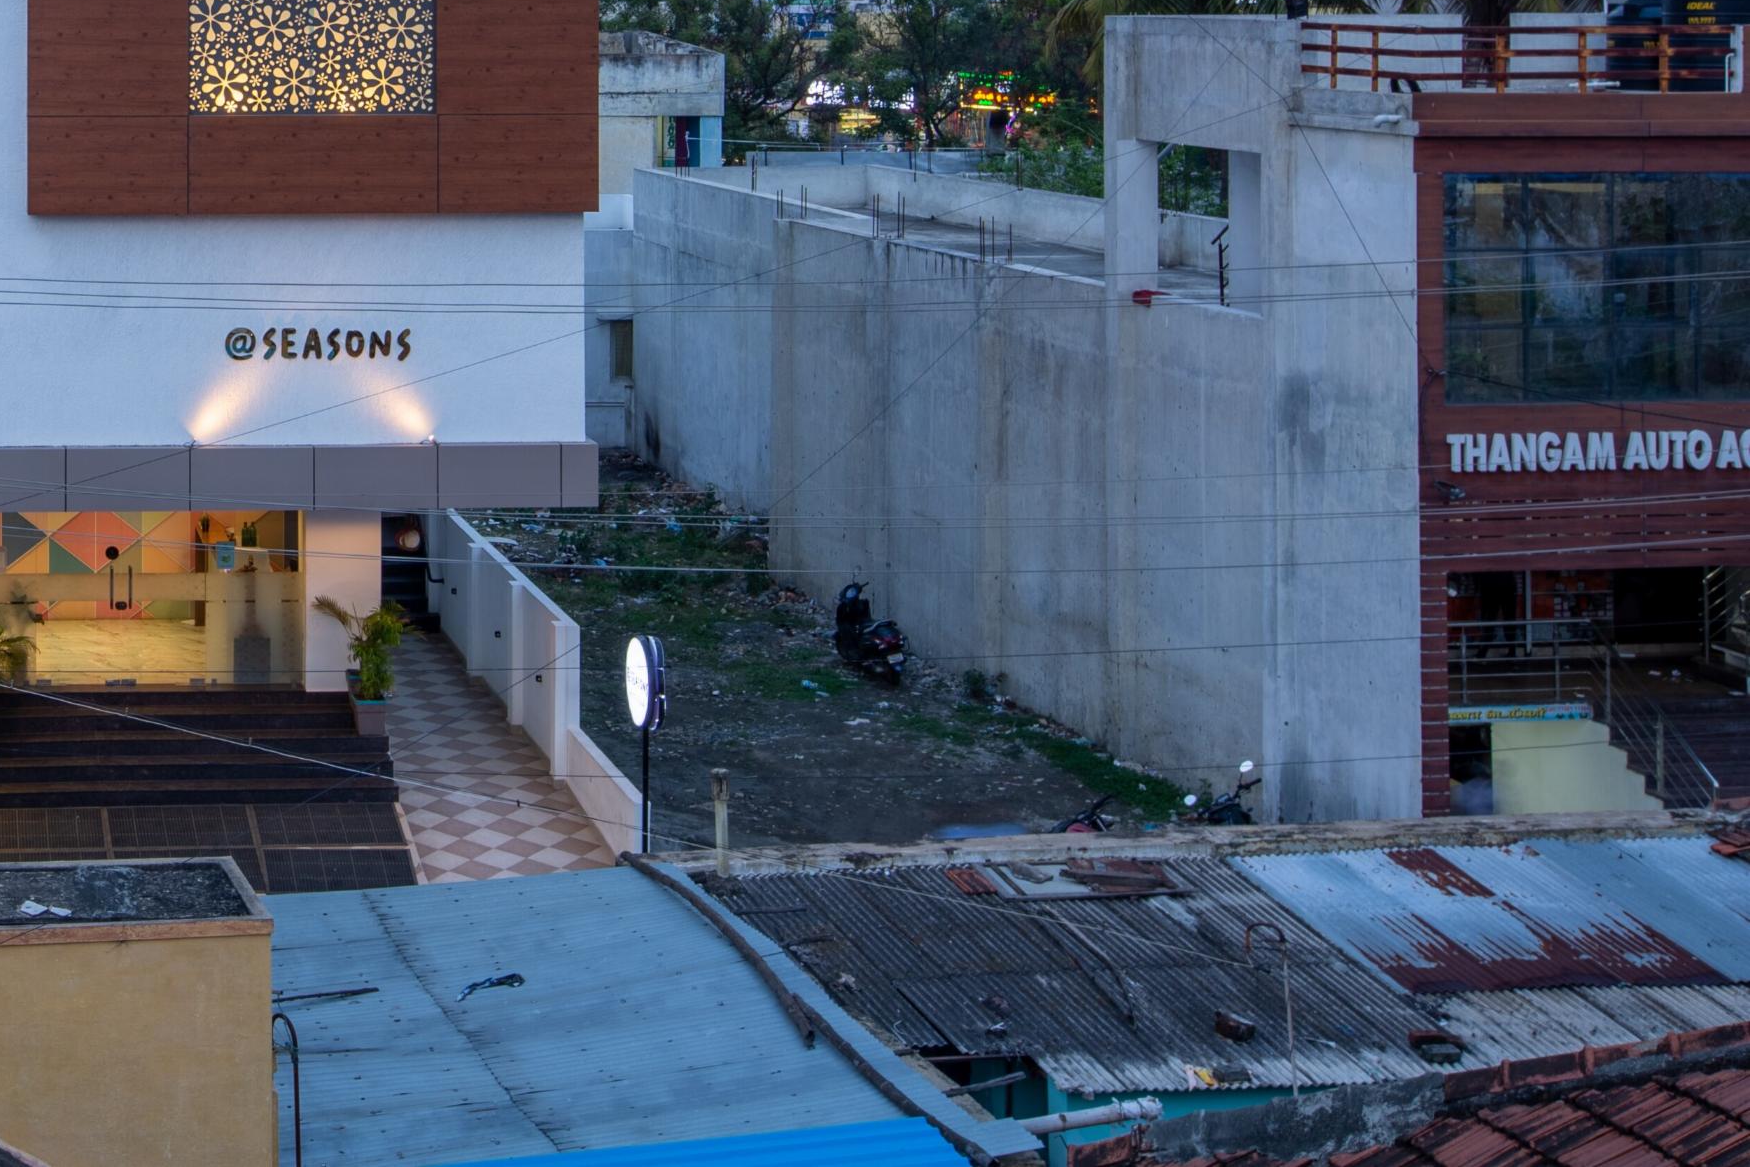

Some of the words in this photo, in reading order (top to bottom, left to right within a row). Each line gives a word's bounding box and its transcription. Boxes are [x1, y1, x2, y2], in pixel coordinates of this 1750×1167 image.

[224, 326, 412, 362] @SEASONS
[1446, 431, 1617, 473] THANGAM
[1623, 428, 1713, 472] AUTO
